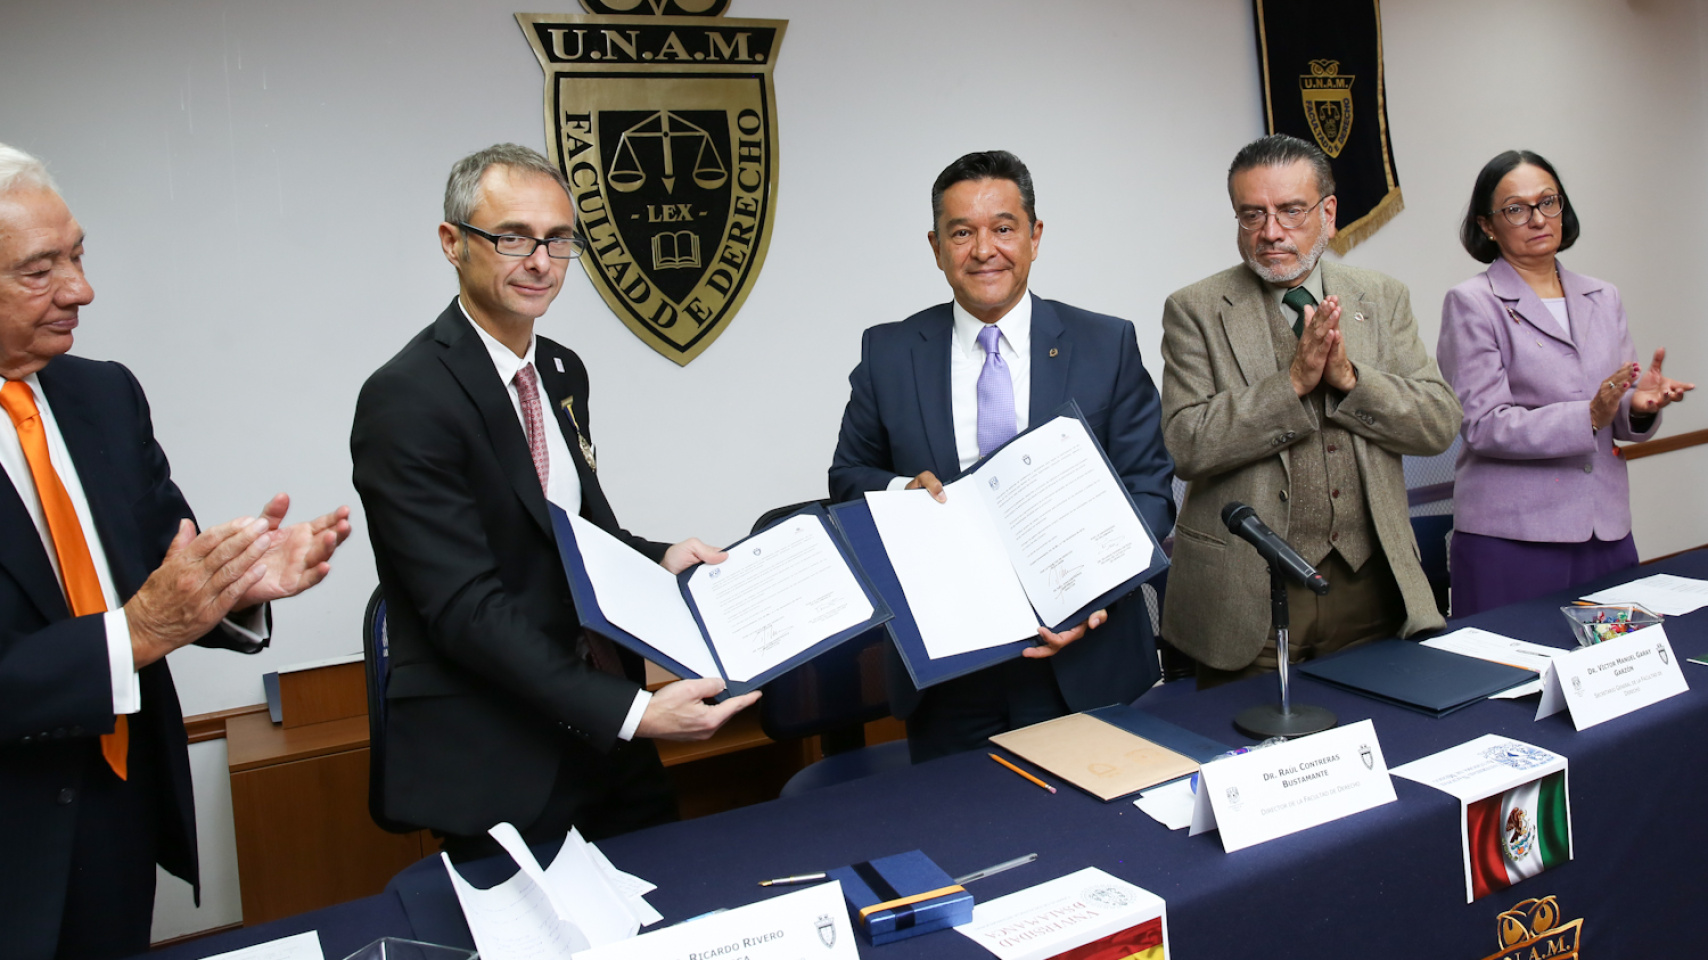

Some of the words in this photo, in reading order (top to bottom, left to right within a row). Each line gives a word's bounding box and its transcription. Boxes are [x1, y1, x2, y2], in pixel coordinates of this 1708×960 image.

[548, 29, 765, 62] U.N.A.M.
[1304, 79, 1349, 89] U.N.A.M.
[565, 110, 652, 305] FACULTAD
[649, 297, 713, 329] DE
[705, 108, 762, 299] DERECHO
[647, 204, 694, 223] LEX
[1263, 771, 1278, 782] DR.
[1299, 754, 1341, 771] CONTRERAS
[1282, 769, 1329, 788] BUSTAMANTE
[743, 930, 785, 949] RIVERO
